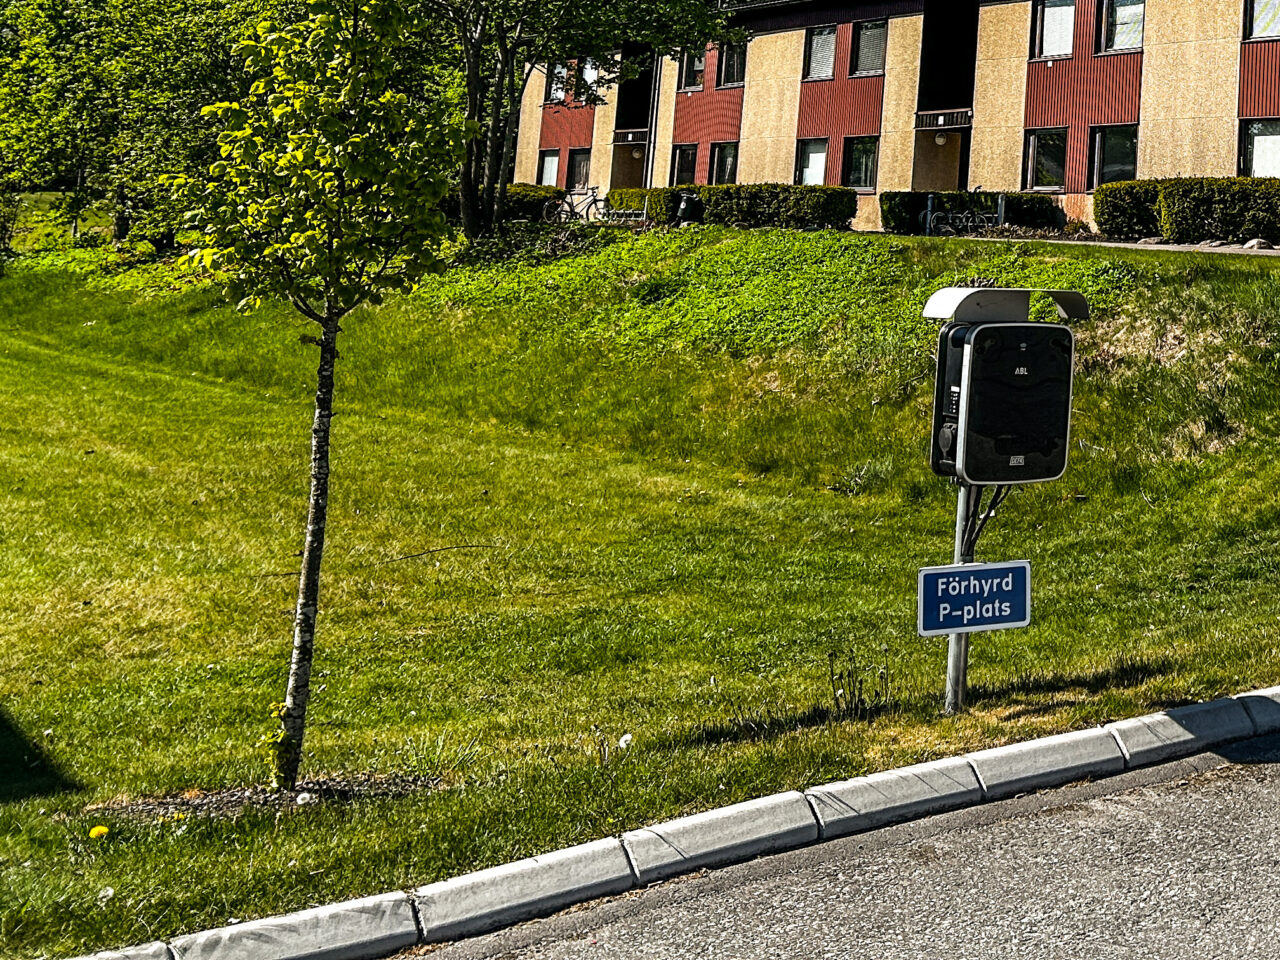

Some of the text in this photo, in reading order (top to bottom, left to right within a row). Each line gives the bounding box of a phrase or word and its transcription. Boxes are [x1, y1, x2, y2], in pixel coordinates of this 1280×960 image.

[1014, 367, 1028, 375] ABL
[938, 573, 1012, 597] Förhyrd
[939, 599, 1011, 624] P-plats
